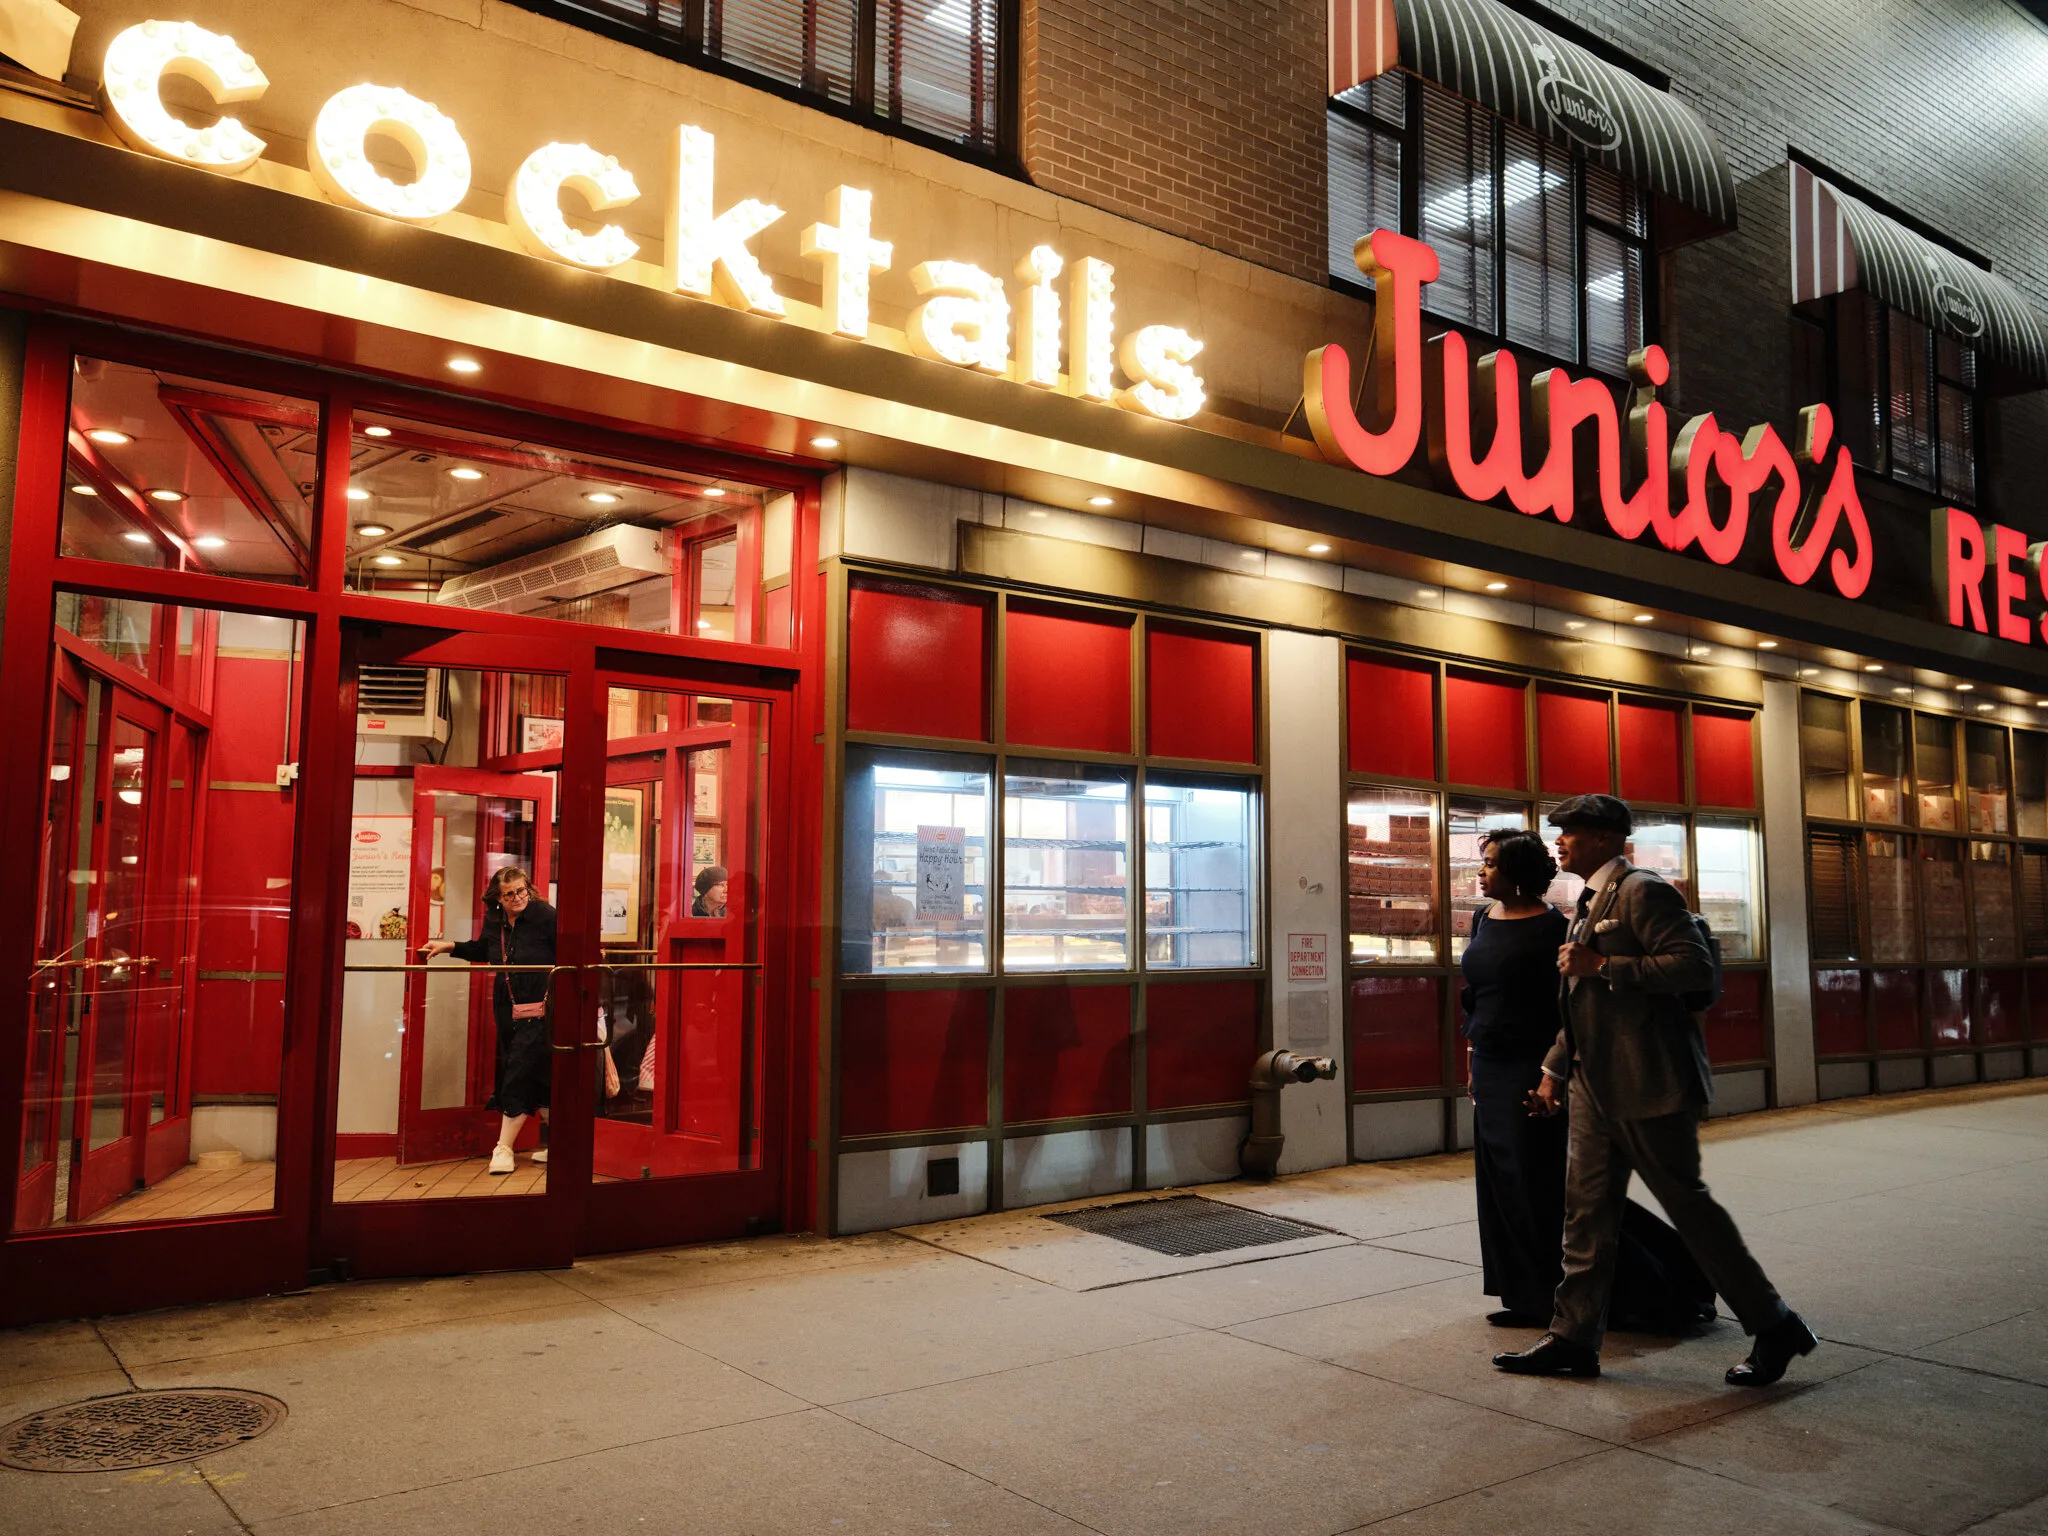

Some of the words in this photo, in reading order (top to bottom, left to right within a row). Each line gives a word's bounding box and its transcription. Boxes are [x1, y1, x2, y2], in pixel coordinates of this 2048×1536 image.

[1550, 75, 1614, 137] Junior's
[100, 19, 1207, 421] cocktails
[1306, 228, 1874, 601] Junior's
[919, 853, 943, 866] Happy
[944, 854, 963, 864] Hour
[1301, 937, 1313, 949] FIRE
[1290, 951, 1325, 963] DEPARTMENT
[1291, 965, 1324, 977] CONNECTION
